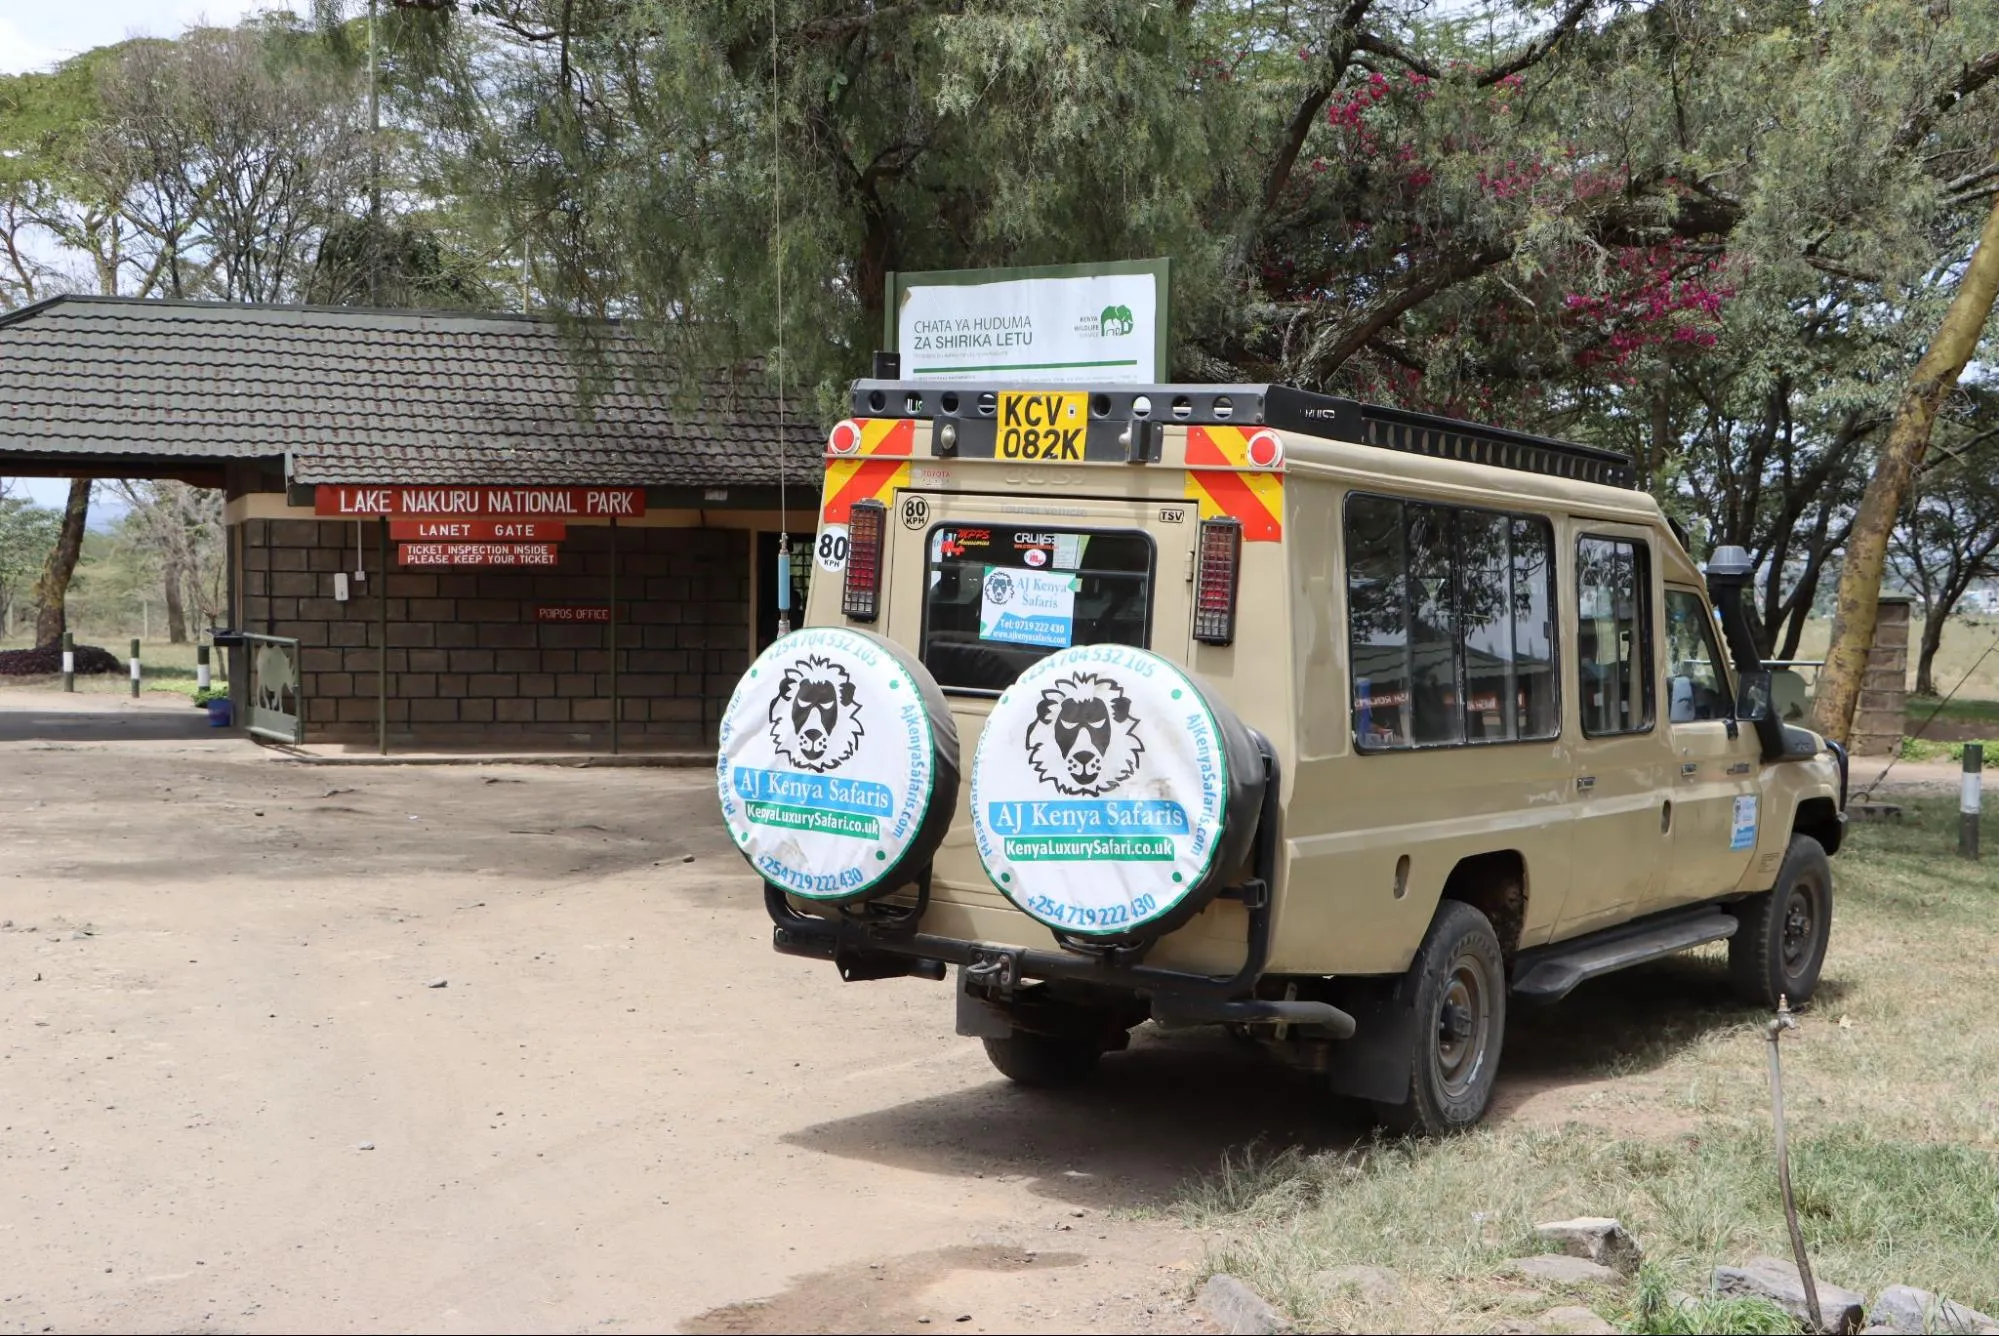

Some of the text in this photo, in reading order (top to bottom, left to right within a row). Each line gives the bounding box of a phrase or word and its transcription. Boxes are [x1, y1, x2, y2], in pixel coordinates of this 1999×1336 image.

[913, 315, 1032, 334] CHATA YA HUDUMA
[913, 331, 1033, 350] ZA SHIRIKA LETU
[1004, 394, 1064, 428] KCV
[1002, 428, 1085, 461] 082K
[922, 470, 952, 478] TOYOTA
[340, 489, 634, 514] LAKE NAKURU NATIONAL PARK
[905, 500, 926, 517] 80
[906, 516, 925, 525] KPH
[1161, 510, 1183, 522] TSV
[419, 523, 535, 537] LANET GATE
[406, 545, 549, 555] TICKET INSPECTION INSIDE
[818, 533, 848, 561] 80
[407, 555, 555, 564] PLEASE KEEP YOUR TICKET
[823, 558, 841, 568] KPH
[1033, 578, 1067, 596] Kenya
[1022, 593, 1058, 609] Safaris
[576, 608, 609, 620] OFFICE
[892, 703, 926, 839] AjKenyaSafaris.com
[739, 768, 890, 809] AJ Kenya Safaris
[1185, 713, 1217, 856] AjKenyaSafaris.com
[747, 805, 879, 835] KenyaLuxurySafari.co.uk
[996, 802, 1184, 835] AJ Kenya Safaris
[1006, 838, 1173, 859] KenyaLuxurySafari.co.uk
